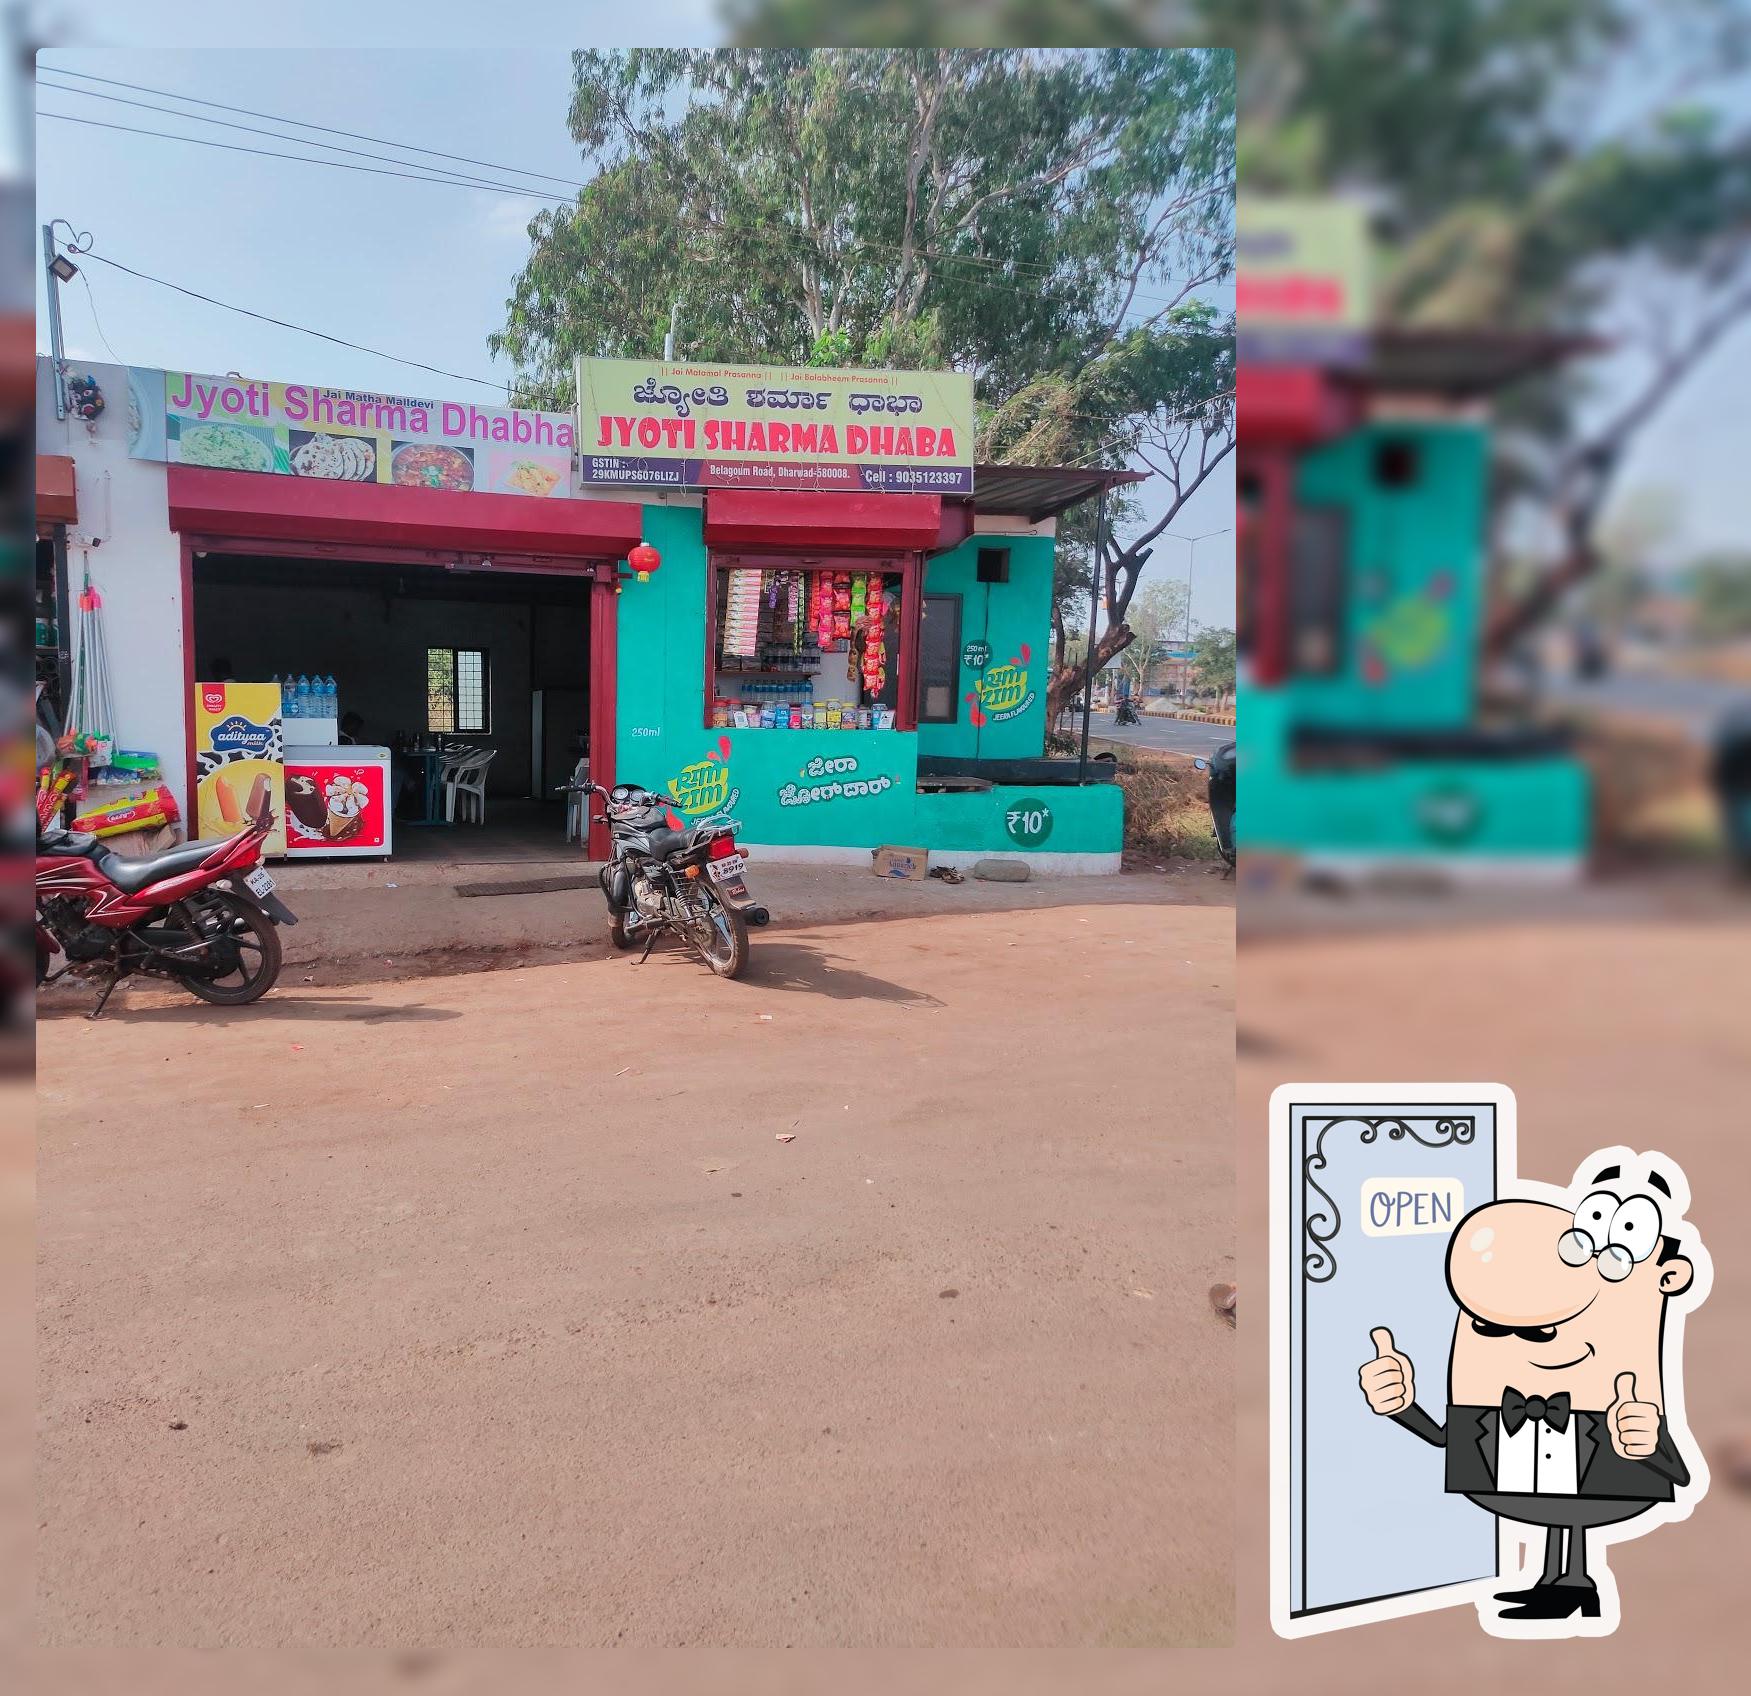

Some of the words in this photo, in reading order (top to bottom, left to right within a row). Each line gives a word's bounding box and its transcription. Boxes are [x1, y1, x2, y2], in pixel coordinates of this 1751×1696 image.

[671, 367, 683, 376] Jai
[724, 369, 762, 379] Prasanna
[804, 373, 849, 383] Balabheem
[851, 375, 888, 384] Prasanna
[323, 390, 341, 399] Jai
[345, 391, 382, 404] Matha
[633, 377, 729, 418] ಜ್ಯೋತಿ
[746, 388, 832, 410] ಶರ್ಮಾ
[172, 374, 269, 420] Jyoti
[285, 386, 429, 433] Sharma
[442, 403, 574, 447] Dhabha
[597, 415, 696, 450] JYOTI
[703, 419, 839, 454] SHARMA
[846, 424, 957, 457] DHABA
[592, 457, 619, 468] GSTIN
[752, 465, 776, 477] Road,
[865, 469, 886, 482] Cell
[895, 471, 963, 485] 9035123397
[217, 731, 267, 745] adityaa
[631, 727, 661, 737] 250ml
[807, 757, 858, 777] ಜೀರಾ
[723, 862, 744, 874] 8919
